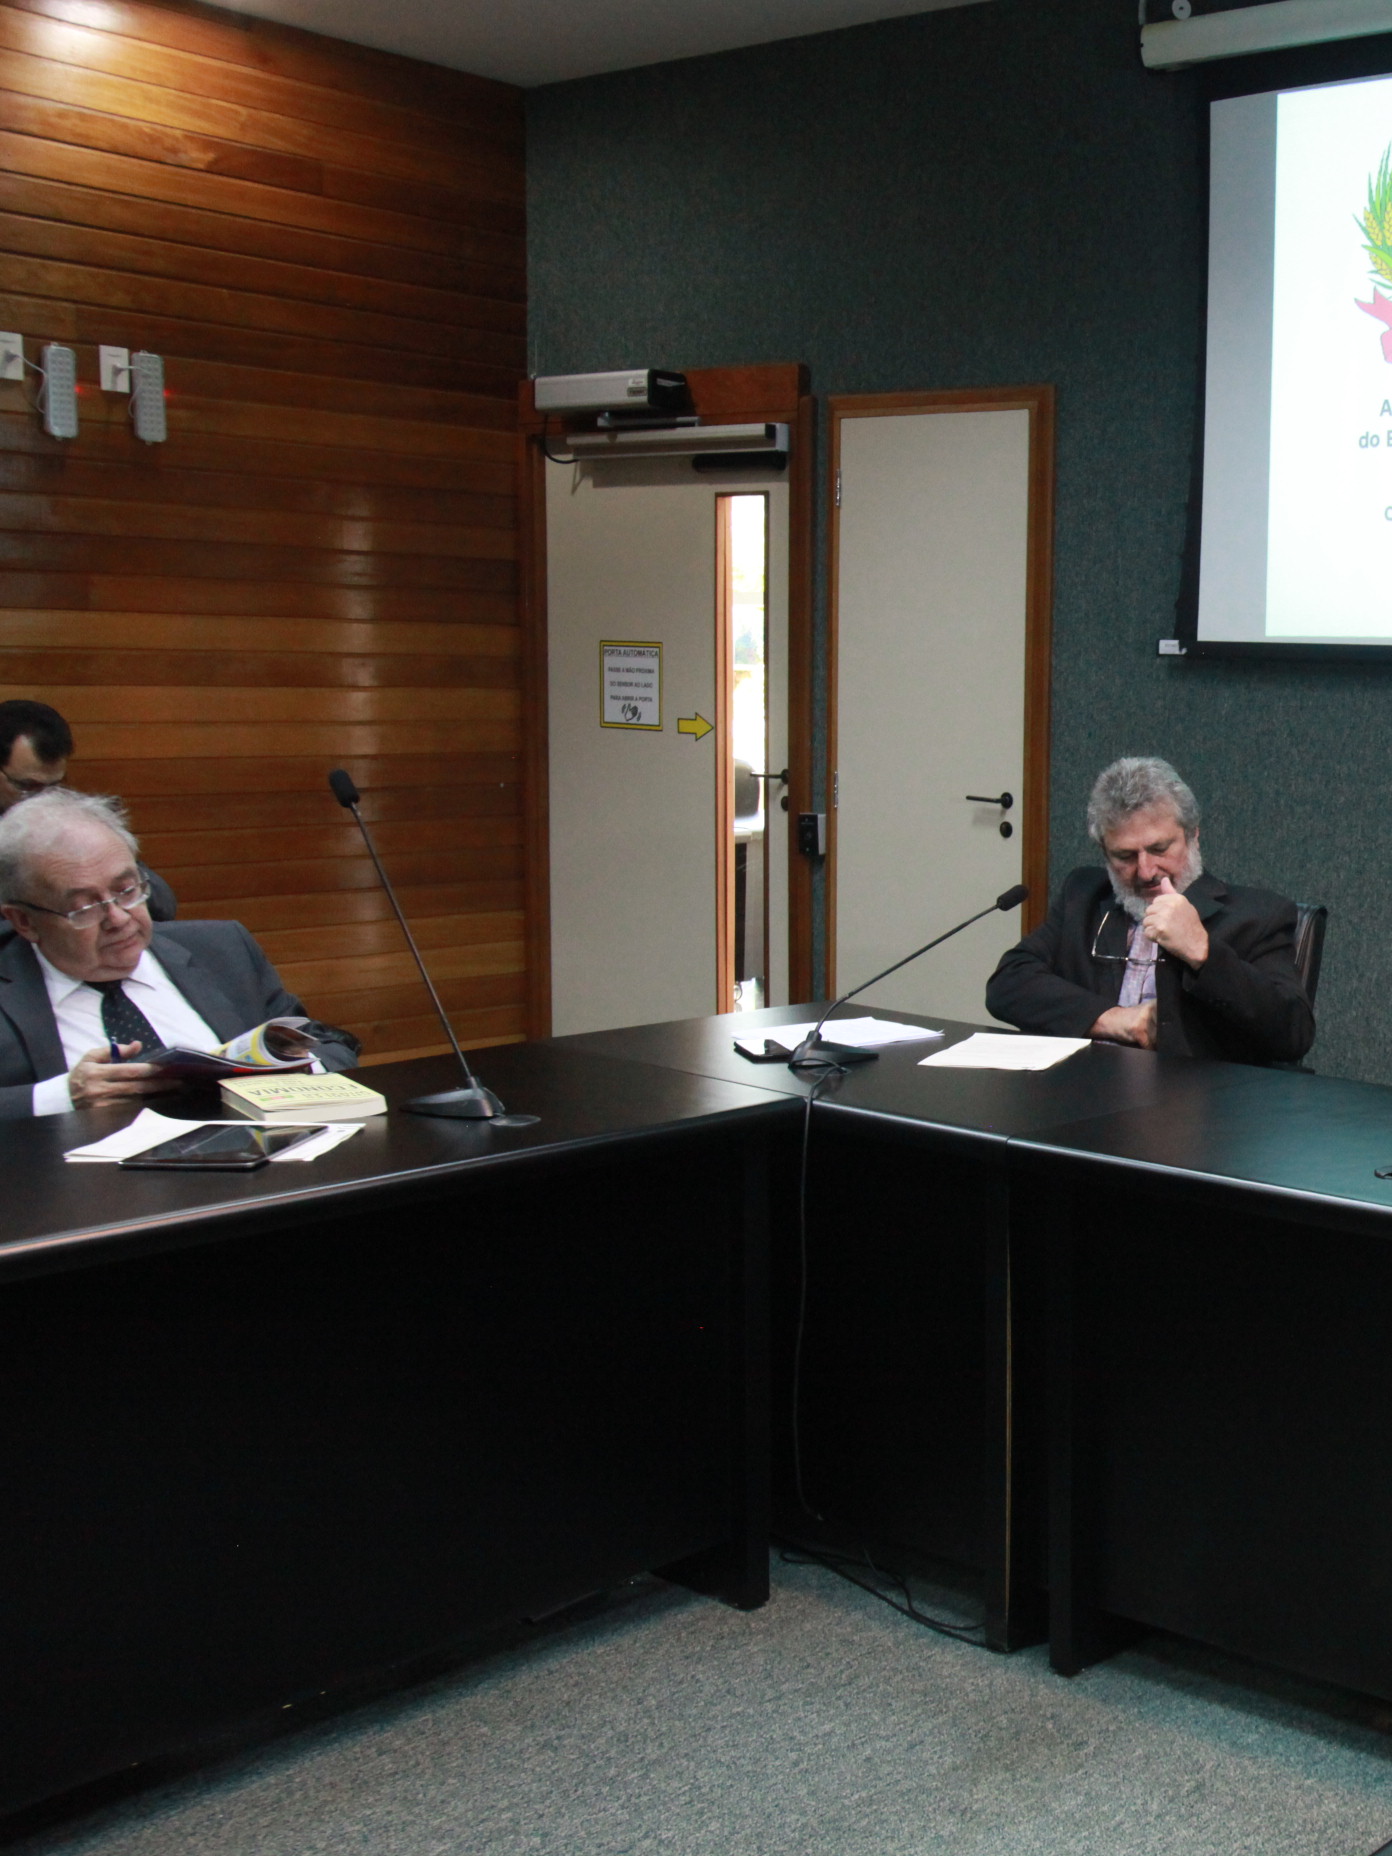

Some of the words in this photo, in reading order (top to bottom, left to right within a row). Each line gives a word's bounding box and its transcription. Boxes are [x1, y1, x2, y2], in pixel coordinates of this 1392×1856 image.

[1358, 431, 1380, 449] do
[604, 648, 622, 657] PORTA
[248, 1084, 359, 1096] ECONOMIA
